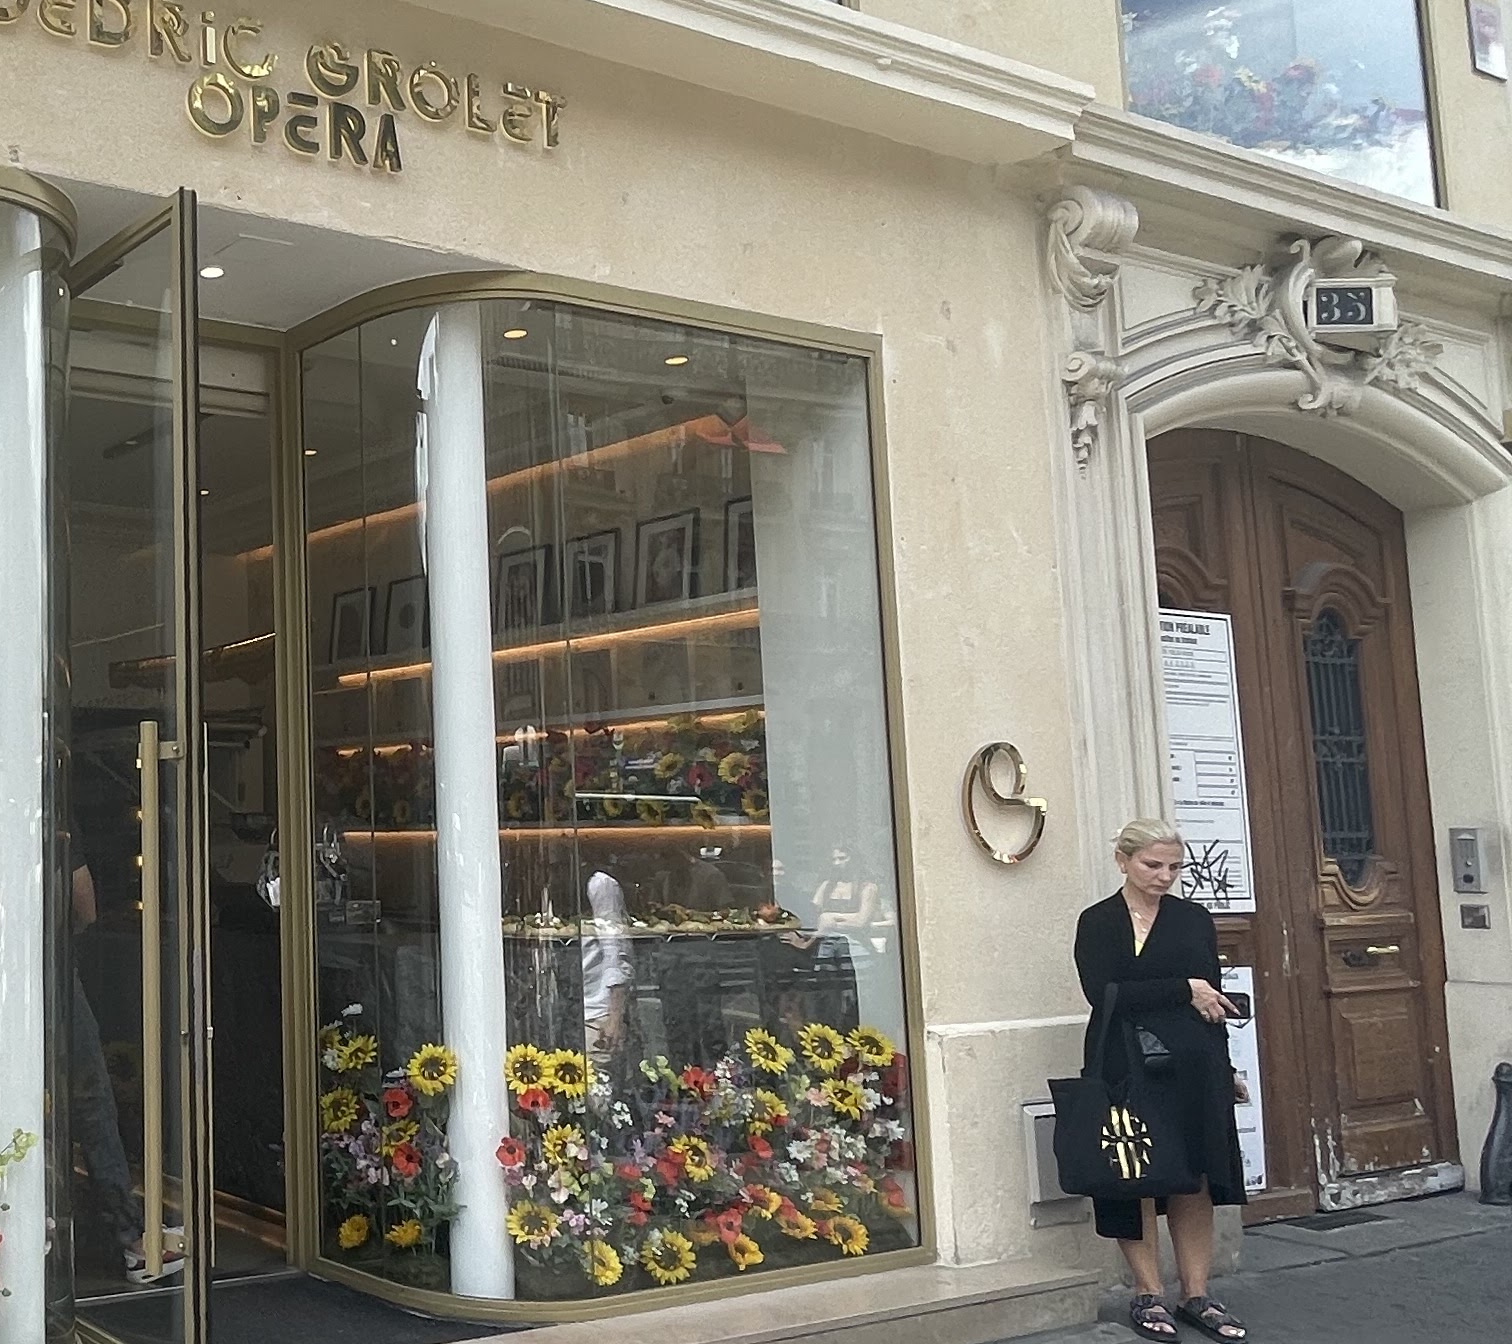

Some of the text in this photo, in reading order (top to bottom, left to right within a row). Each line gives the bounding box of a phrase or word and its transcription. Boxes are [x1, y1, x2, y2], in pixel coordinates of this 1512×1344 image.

[187, 71, 404, 174] OPERA
[305, 41, 568, 149] GROLET
[1321, 292, 1366, 321] 35
